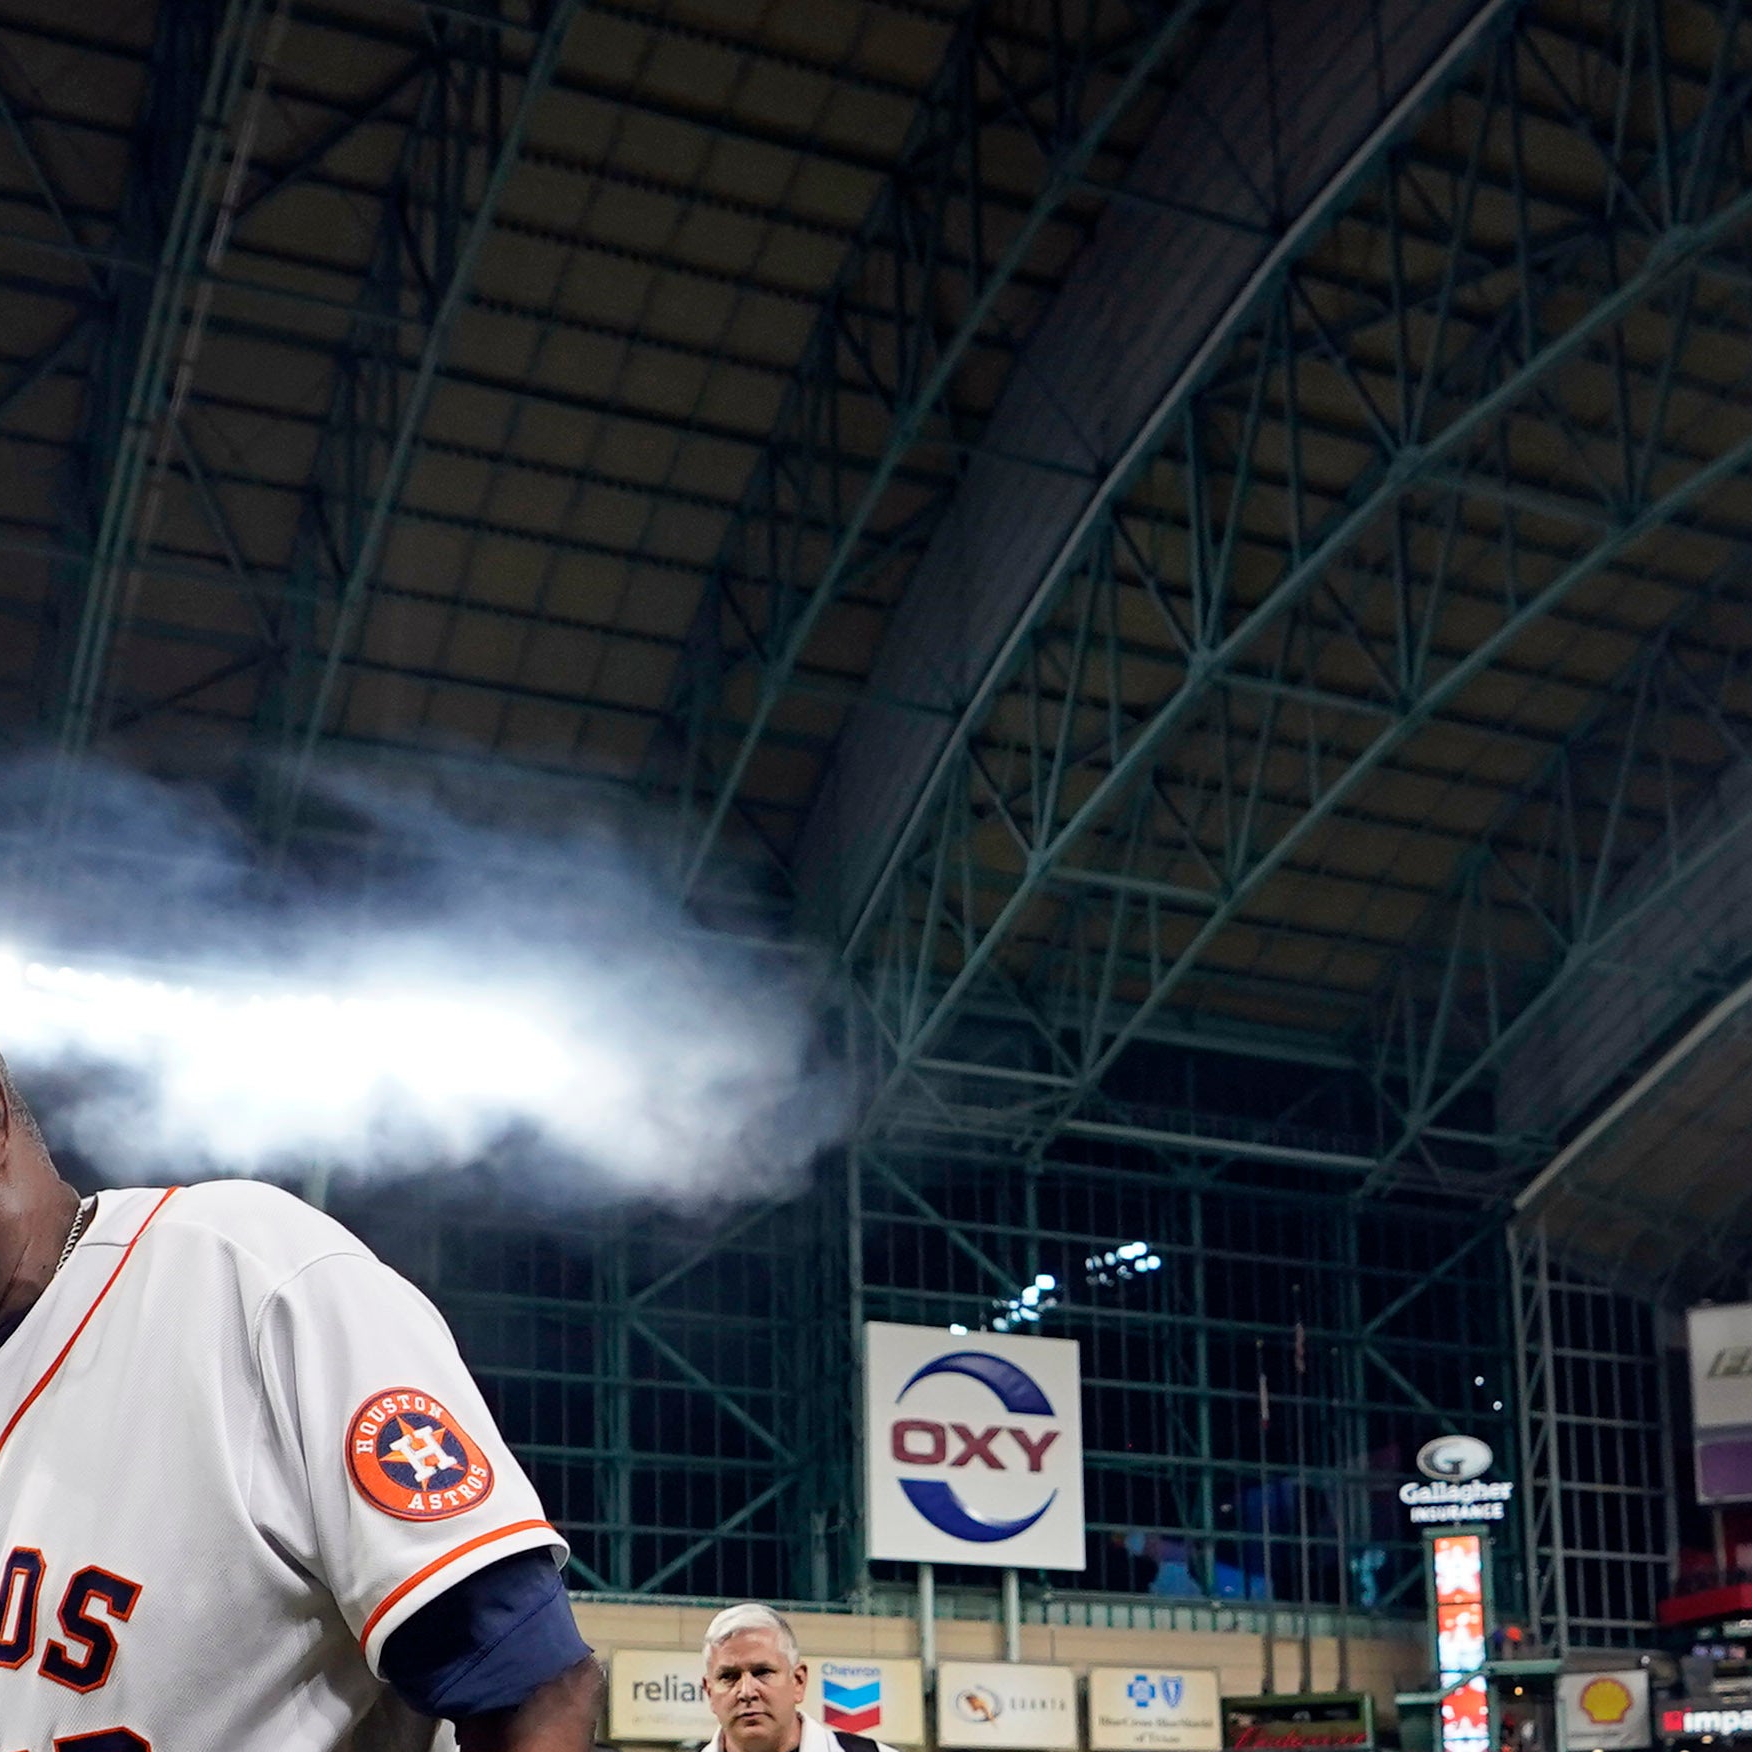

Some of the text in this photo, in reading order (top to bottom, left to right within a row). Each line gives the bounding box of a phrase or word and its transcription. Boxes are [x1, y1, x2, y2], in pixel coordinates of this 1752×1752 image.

[356, 1394, 444, 1455] HOUSTON
[891, 1418, 1062, 1474] OXY
[389, 1425, 459, 1482] H
[408, 1464, 488, 1511] ASTROS
[1399, 1479, 1513, 1506] Gallagher
[1410, 1502, 1505, 1524] INSURANCE
[820, 1661, 882, 1678] Chevron
